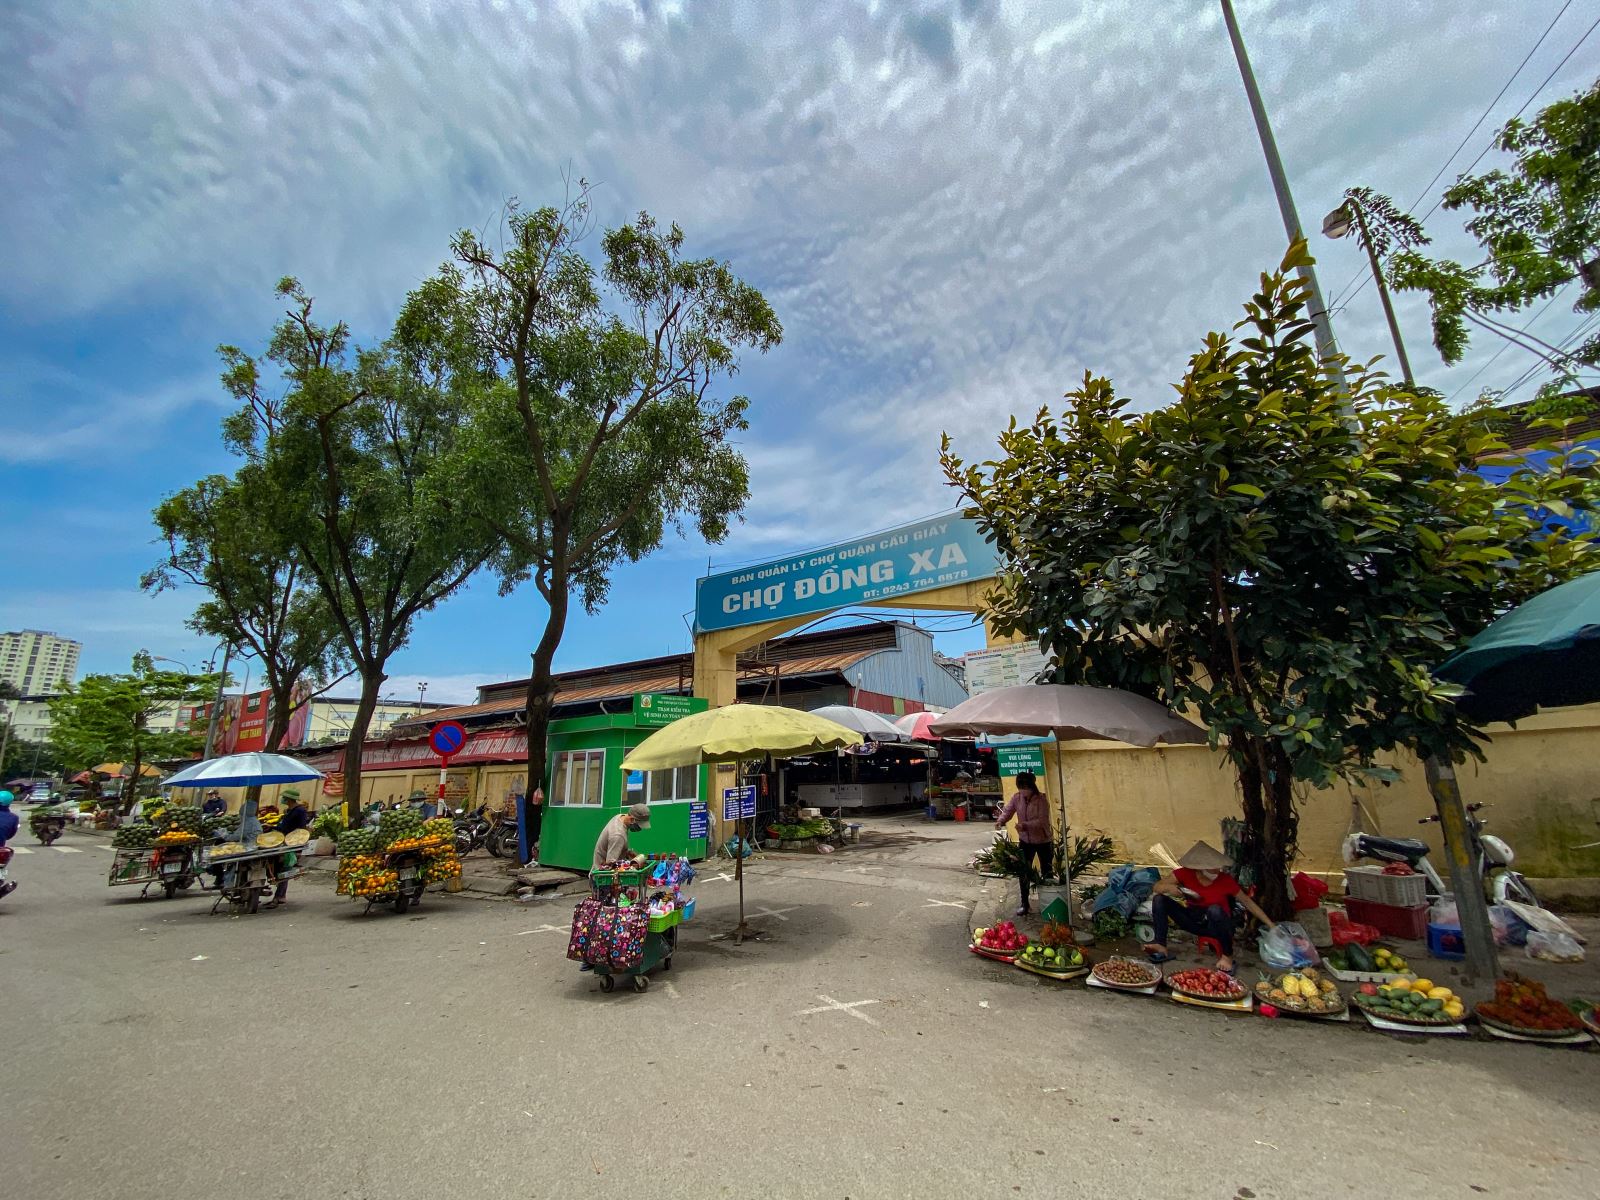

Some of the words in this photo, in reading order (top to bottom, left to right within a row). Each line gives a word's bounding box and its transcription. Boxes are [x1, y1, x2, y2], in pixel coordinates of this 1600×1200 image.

[722, 582, 785, 614] CHỢ
[793, 559, 894, 601] ĐỒNG
[908, 542, 968, 576] XA
[731, 573, 754, 585] BAN
[757, 564, 789, 579] QUẢN
[809, 552, 835, 567] CHỢ
[883, 582, 910, 595] 0243
[913, 577, 935, 589] 764
